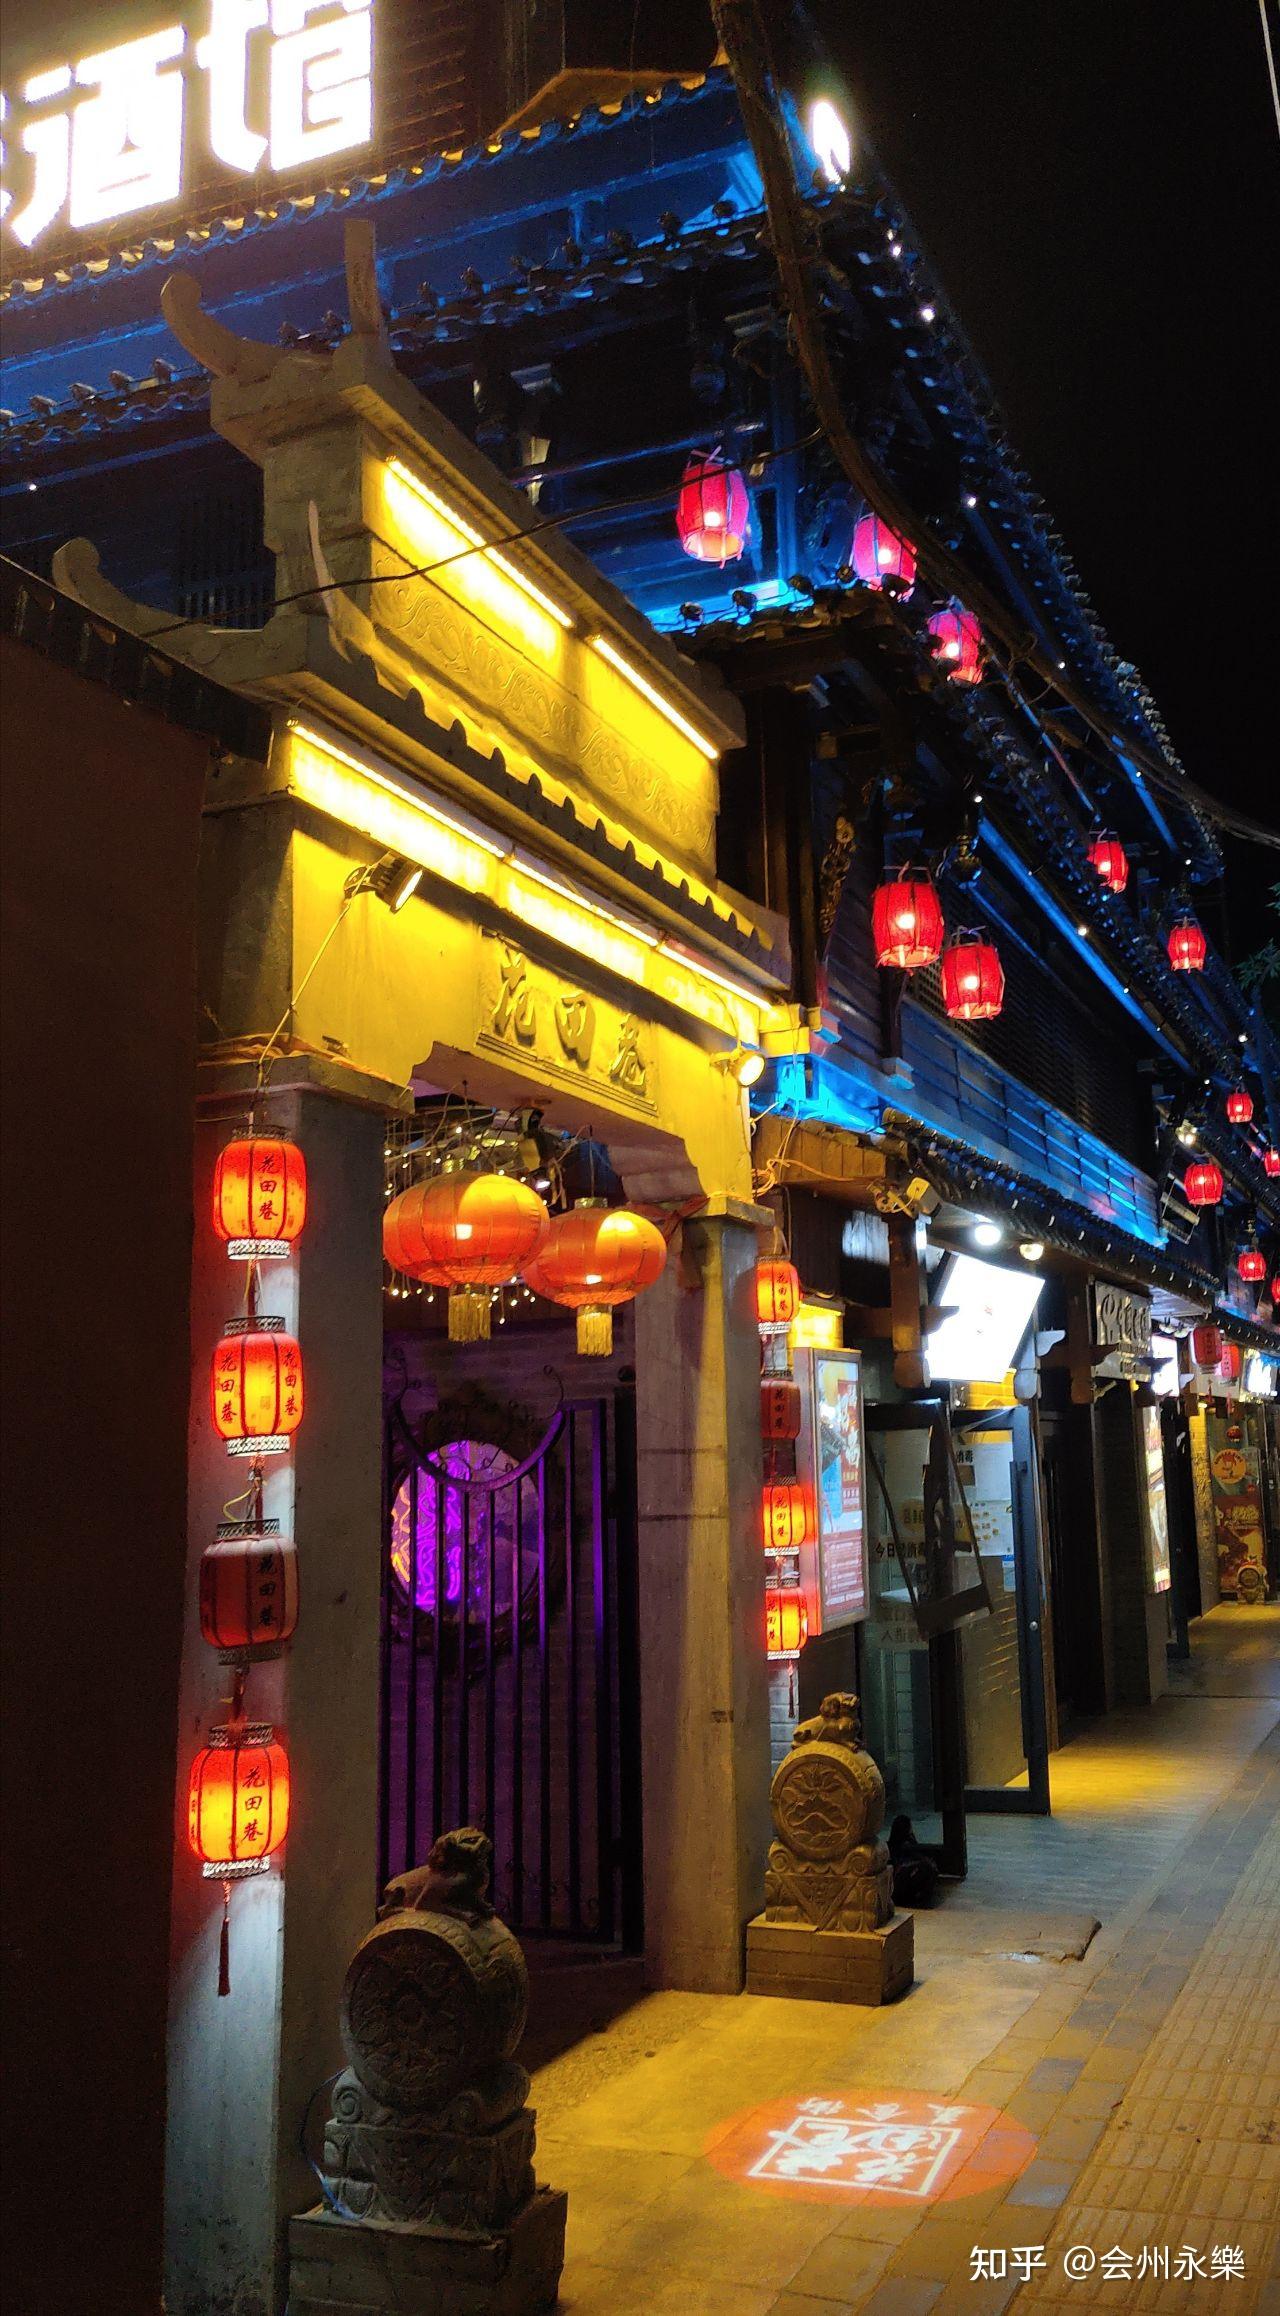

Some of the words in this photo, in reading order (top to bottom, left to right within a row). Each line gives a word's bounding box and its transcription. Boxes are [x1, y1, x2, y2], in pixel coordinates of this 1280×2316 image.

[492, 949, 648, 1095] 花田巷
[257, 1155, 279, 1221] 花田巷
[219, 1350, 238, 1425] 花田巷
[282, 1349, 298, 1416] 花田巷
[258, 1553, 276, 1627] 花田巷
[239, 1766, 266, 1845] 花田巷
